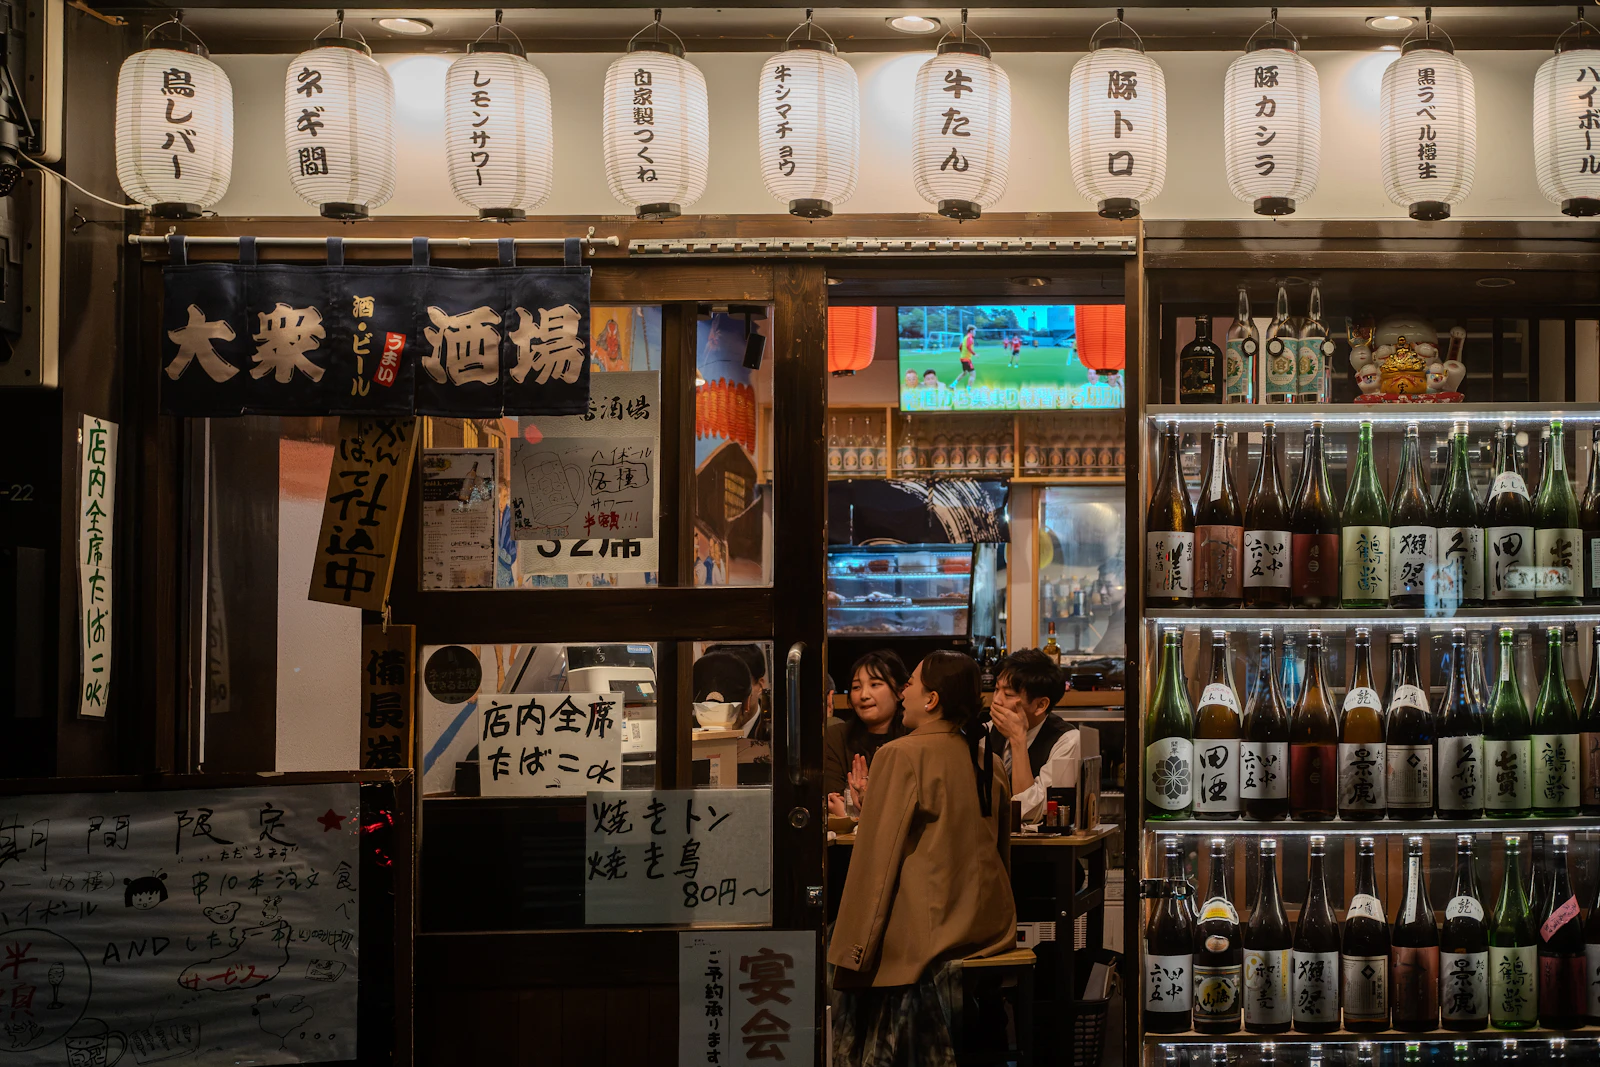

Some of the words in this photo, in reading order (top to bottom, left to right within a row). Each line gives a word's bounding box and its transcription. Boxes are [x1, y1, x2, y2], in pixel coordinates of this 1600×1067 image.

[296, 67, 328, 176] ネギ間
[632, 68, 658, 183] 自家製つくね
[774, 64, 796, 176] 牛シマチョウ
[940, 69, 973, 172] 牛たん
[1108, 70, 1137, 176] 豚トロ
[1254, 65, 1279, 176] 豚カシラ
[1416, 67, 1438, 179] 黒ラベル樽生
[1577, 67, 1600, 174] ハイボール
[352, 295, 376, 397] 酒・ビール
[377, 334, 405, 384] うまい
[591, 499, 633, 511] サワー
[592, 467, 638, 491] 各種
[324, 473, 389, 602] 仕込中
[1400, 533, 1427, 587] 獺祭
[483, 695, 616, 741] 店内全席
[1200, 745, 1228, 803] 田酒
[1349, 748, 1376, 804] 景虎
[1452, 743, 1476, 799] 久保田
[1495, 750, 1518, 797] 七賢
[592, 798, 733, 835] 焼きトン
[588, 838, 701, 880] 焼き鳥
[103, 936, 170, 965] AND
[183, 964, 269, 989] サービス
[739, 947, 795, 1061] 宴会
[1298, 960, 1325, 1015] 獺祭
[1449, 959, 1476, 1015] 景虎
